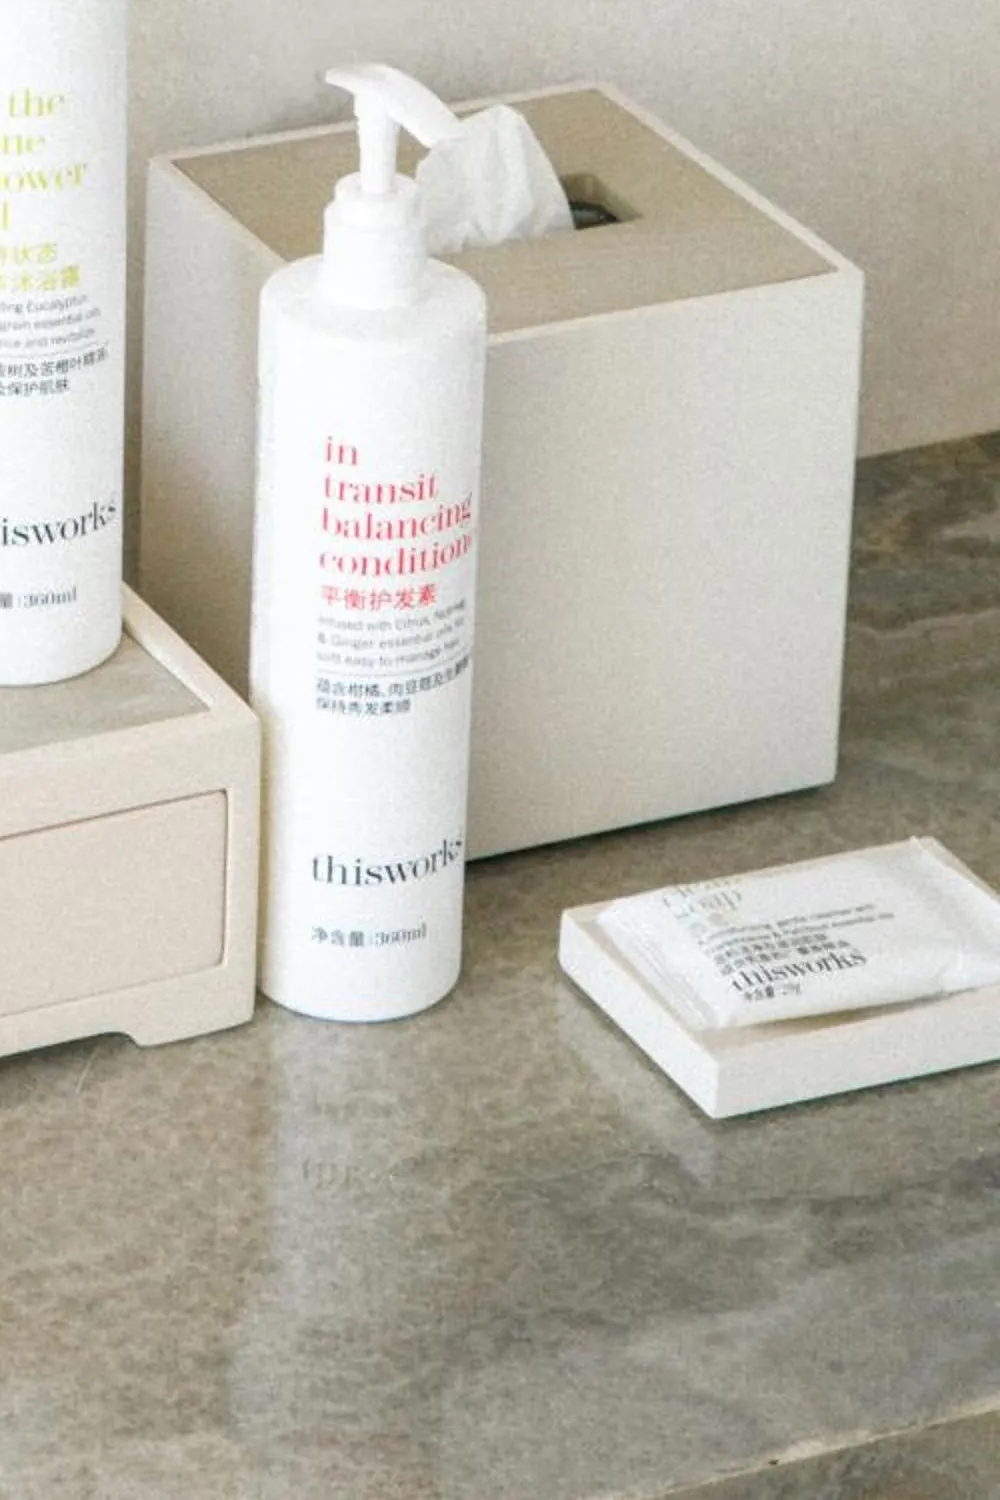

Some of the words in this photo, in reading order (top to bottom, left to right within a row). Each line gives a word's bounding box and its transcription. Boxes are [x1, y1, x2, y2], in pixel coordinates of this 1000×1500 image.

[9, 87, 65, 118] the
[326, 435, 357, 466] in
[325, 473, 438, 503] transit
[322, 491, 473, 541] balancing
[319, 534, 473, 577] condition
[321, 583, 437, 612] 平衡护发素
[732, 950, 868, 992] thisworks
